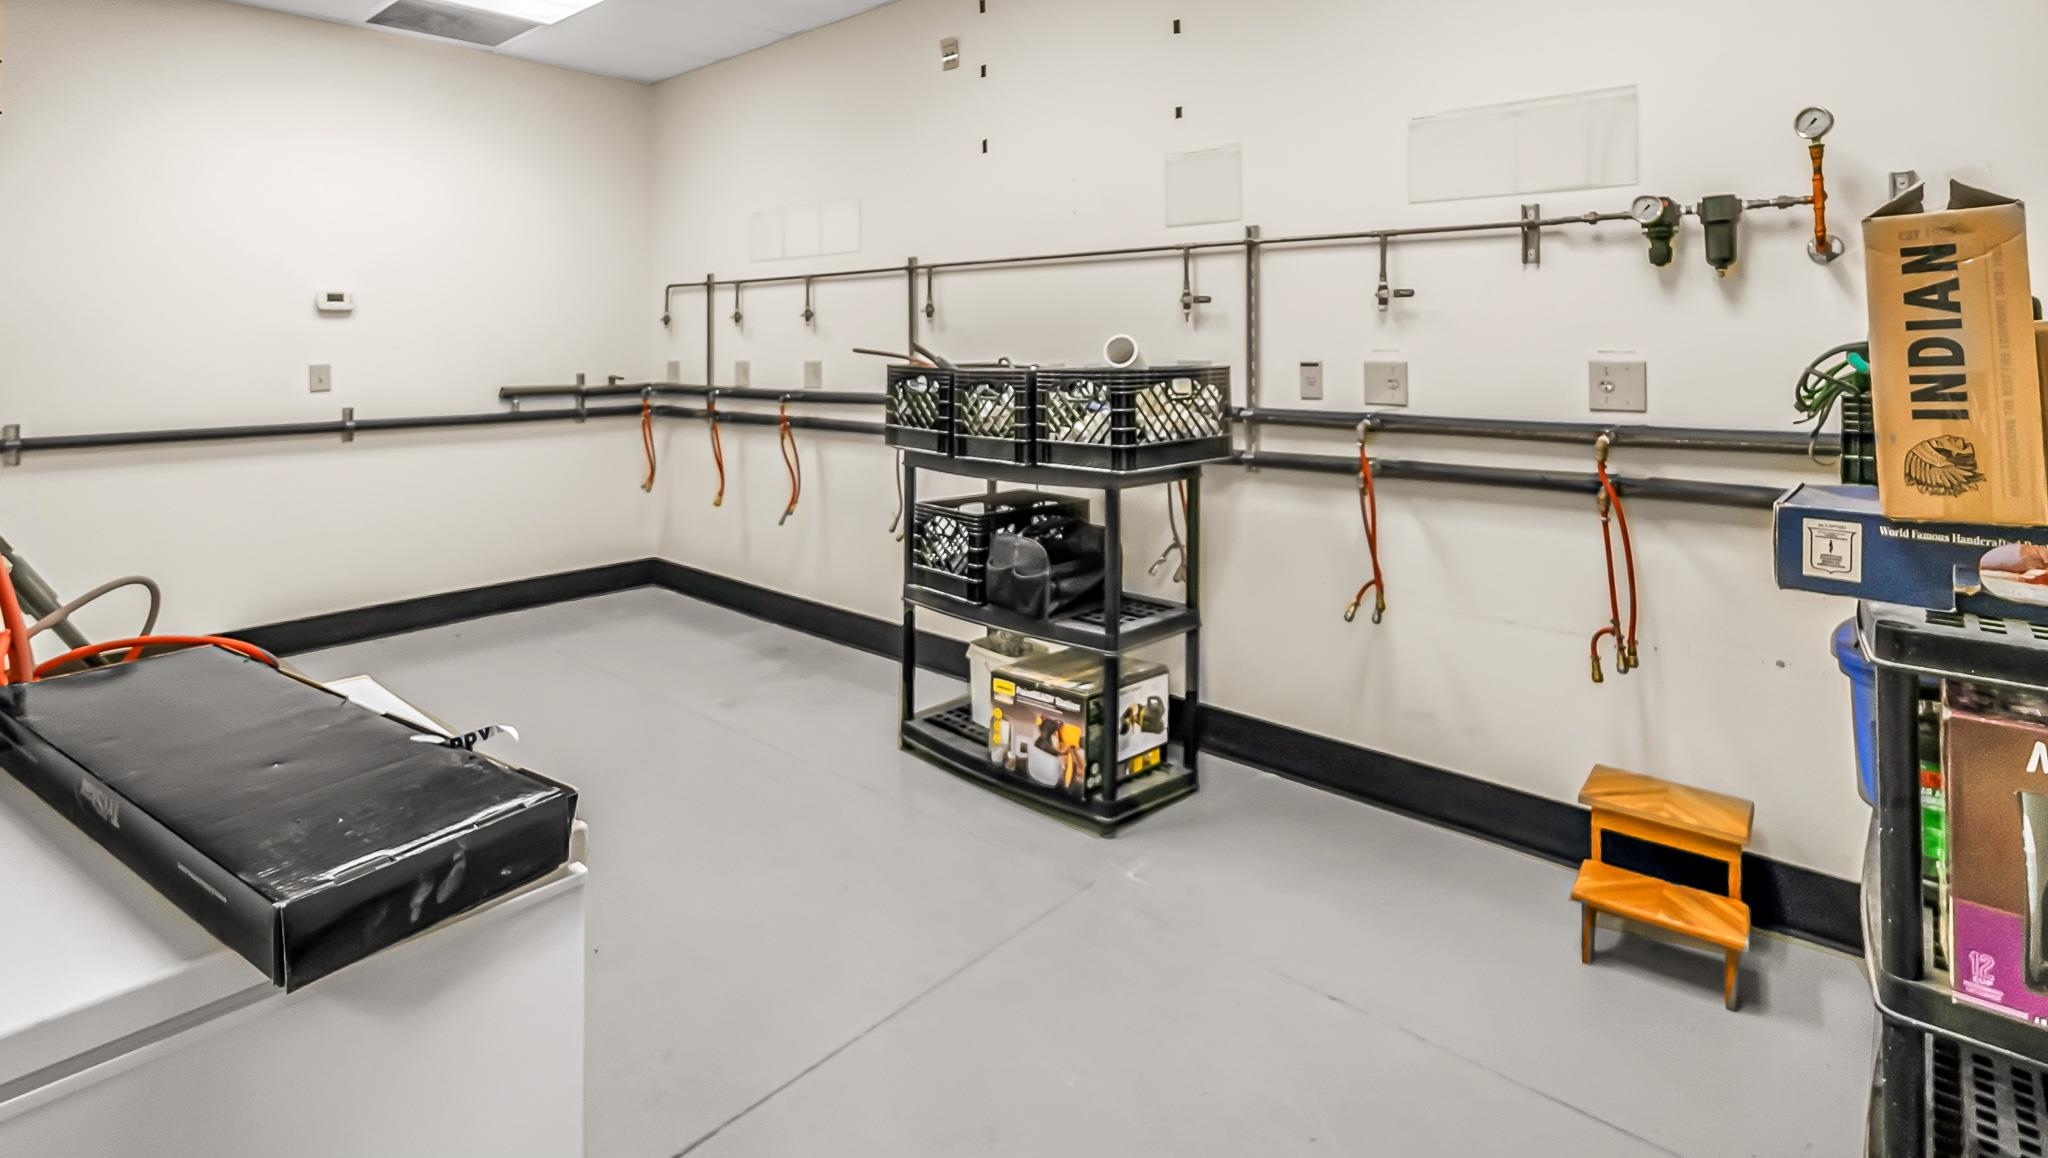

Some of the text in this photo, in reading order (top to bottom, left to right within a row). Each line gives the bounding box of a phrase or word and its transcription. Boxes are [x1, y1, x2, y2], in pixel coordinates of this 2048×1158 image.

[1900, 243, 1969, 420] INDIAN
[1879, 525, 1910, 538] World
[1911, 529, 1950, 542] Famous
[1952, 533, 2021, 547] Handcraf
[1968, 950, 1995, 987] 12
